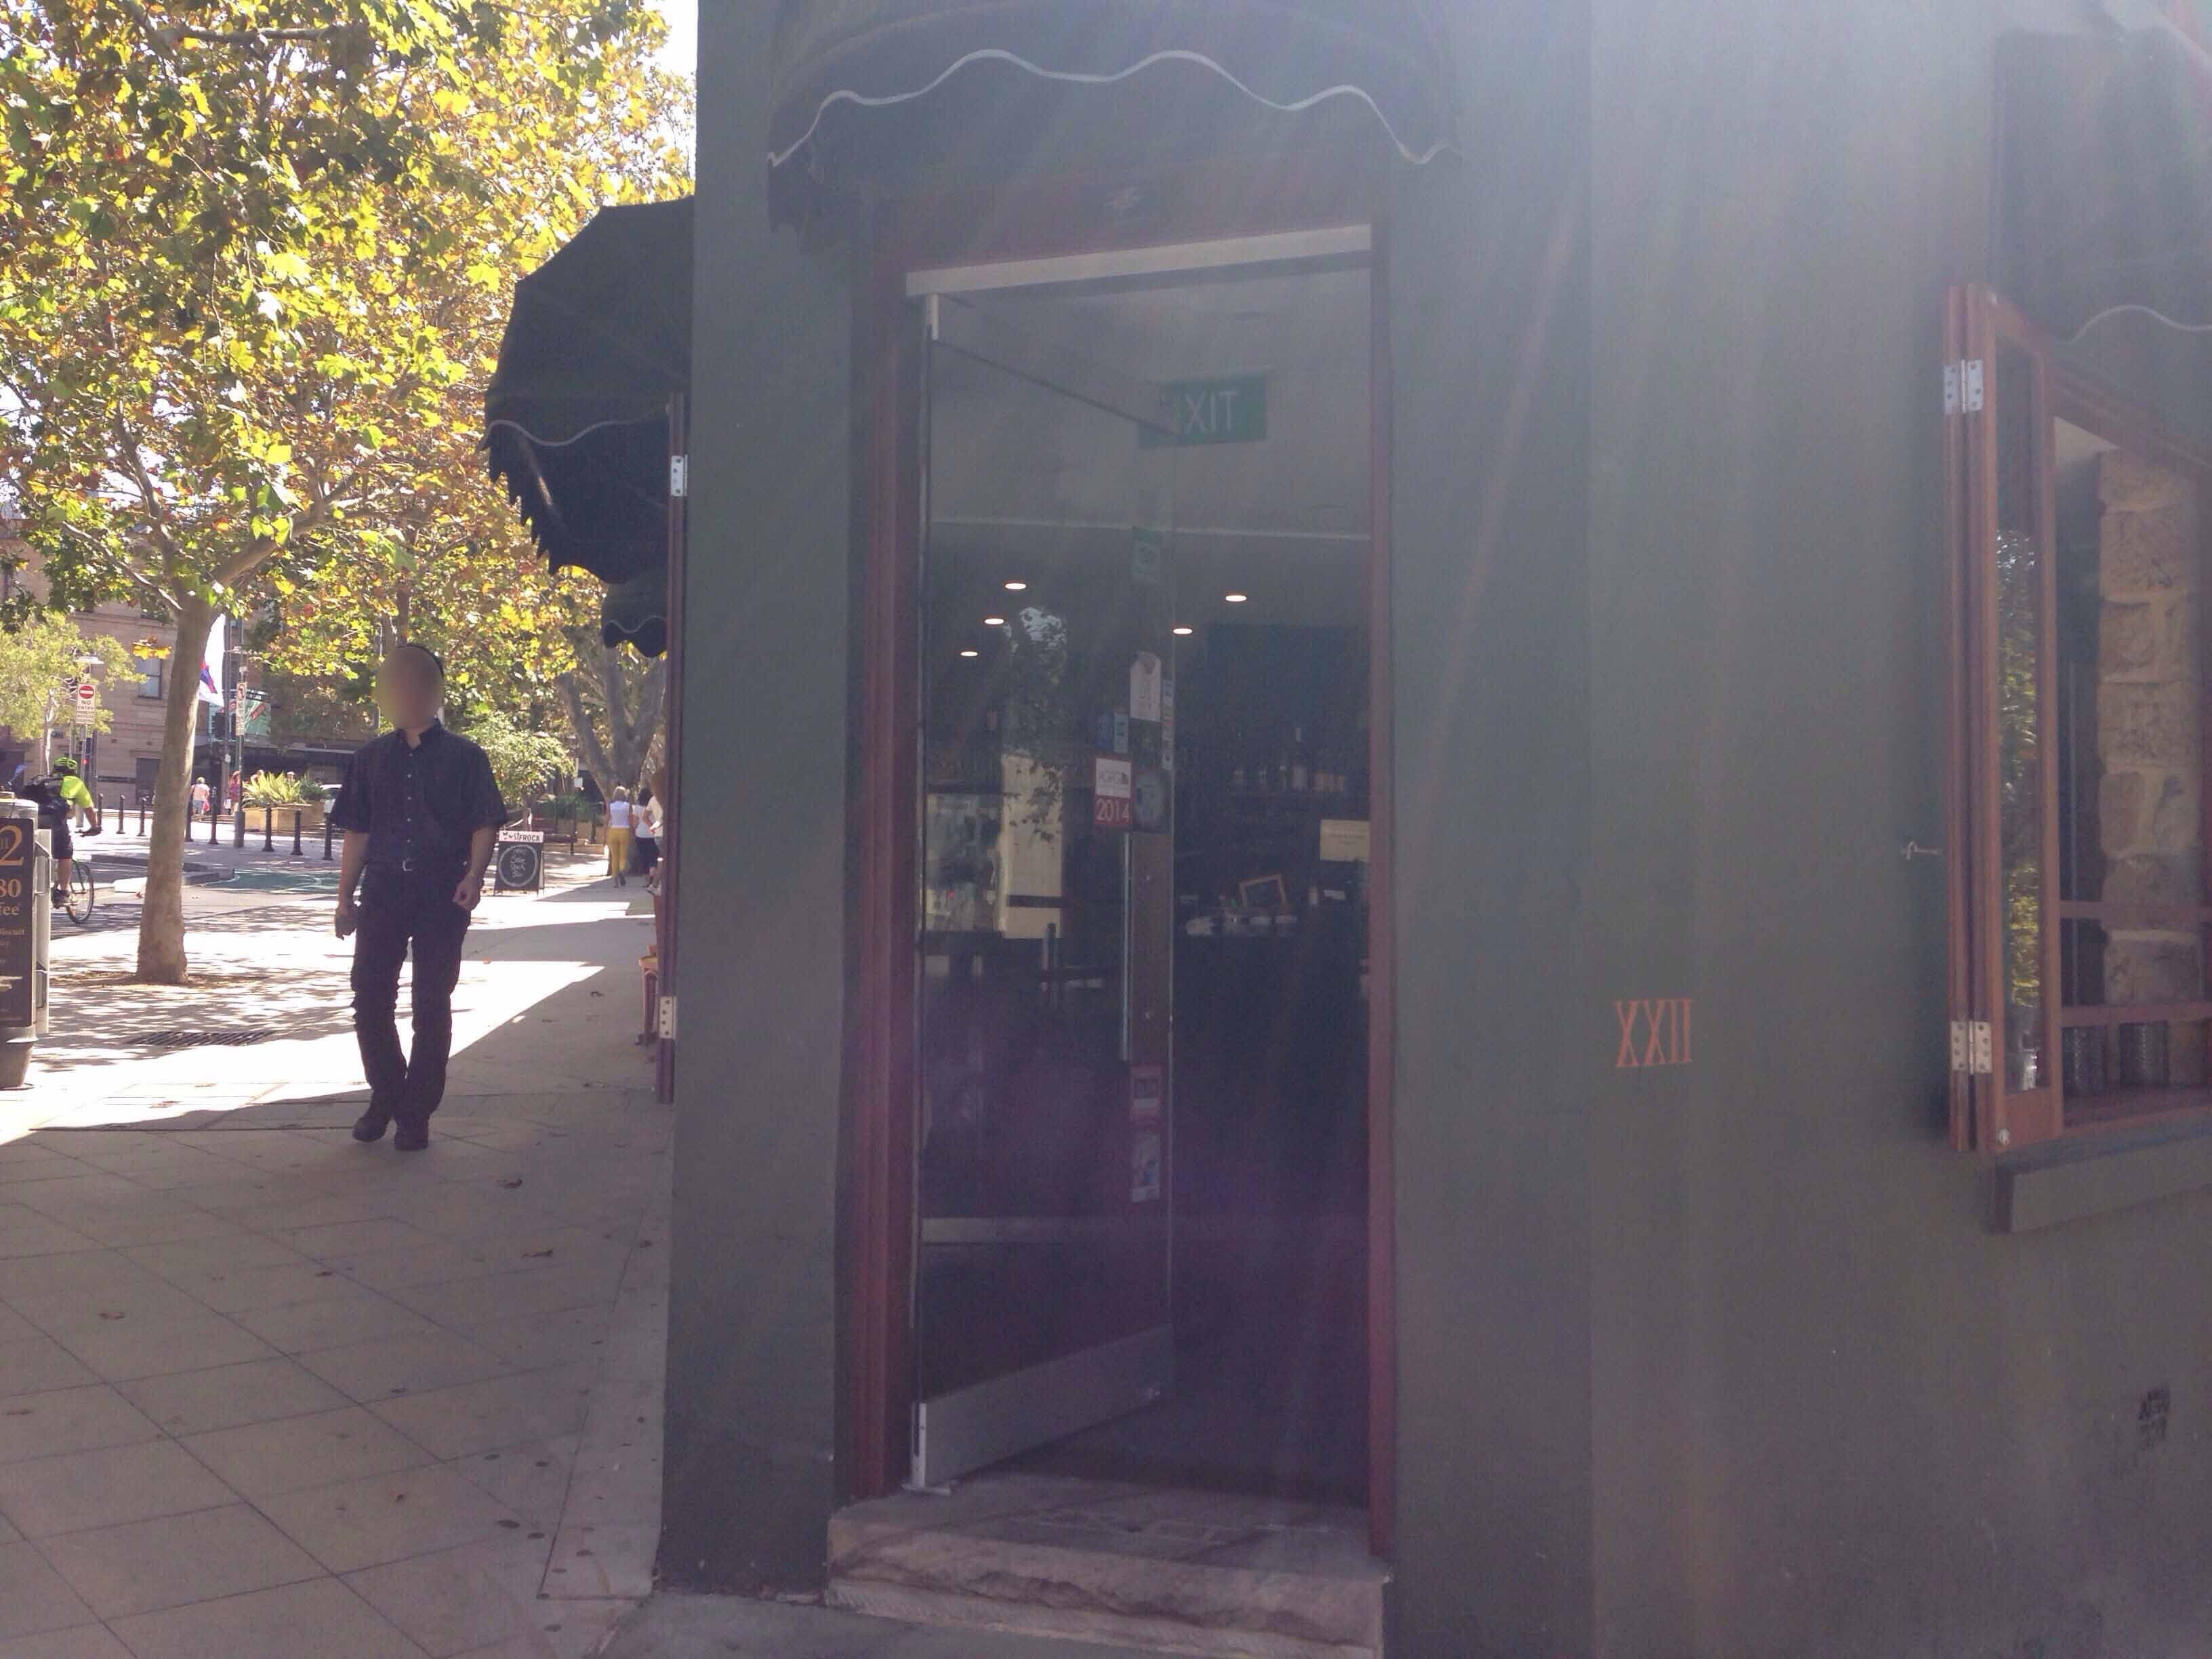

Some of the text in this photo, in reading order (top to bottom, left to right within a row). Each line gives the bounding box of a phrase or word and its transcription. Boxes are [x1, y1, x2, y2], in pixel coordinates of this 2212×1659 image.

[1172, 391, 1237, 434] XIT
[1096, 798, 1130, 822] 2014
[1615, 998, 1692, 1067] XXII
